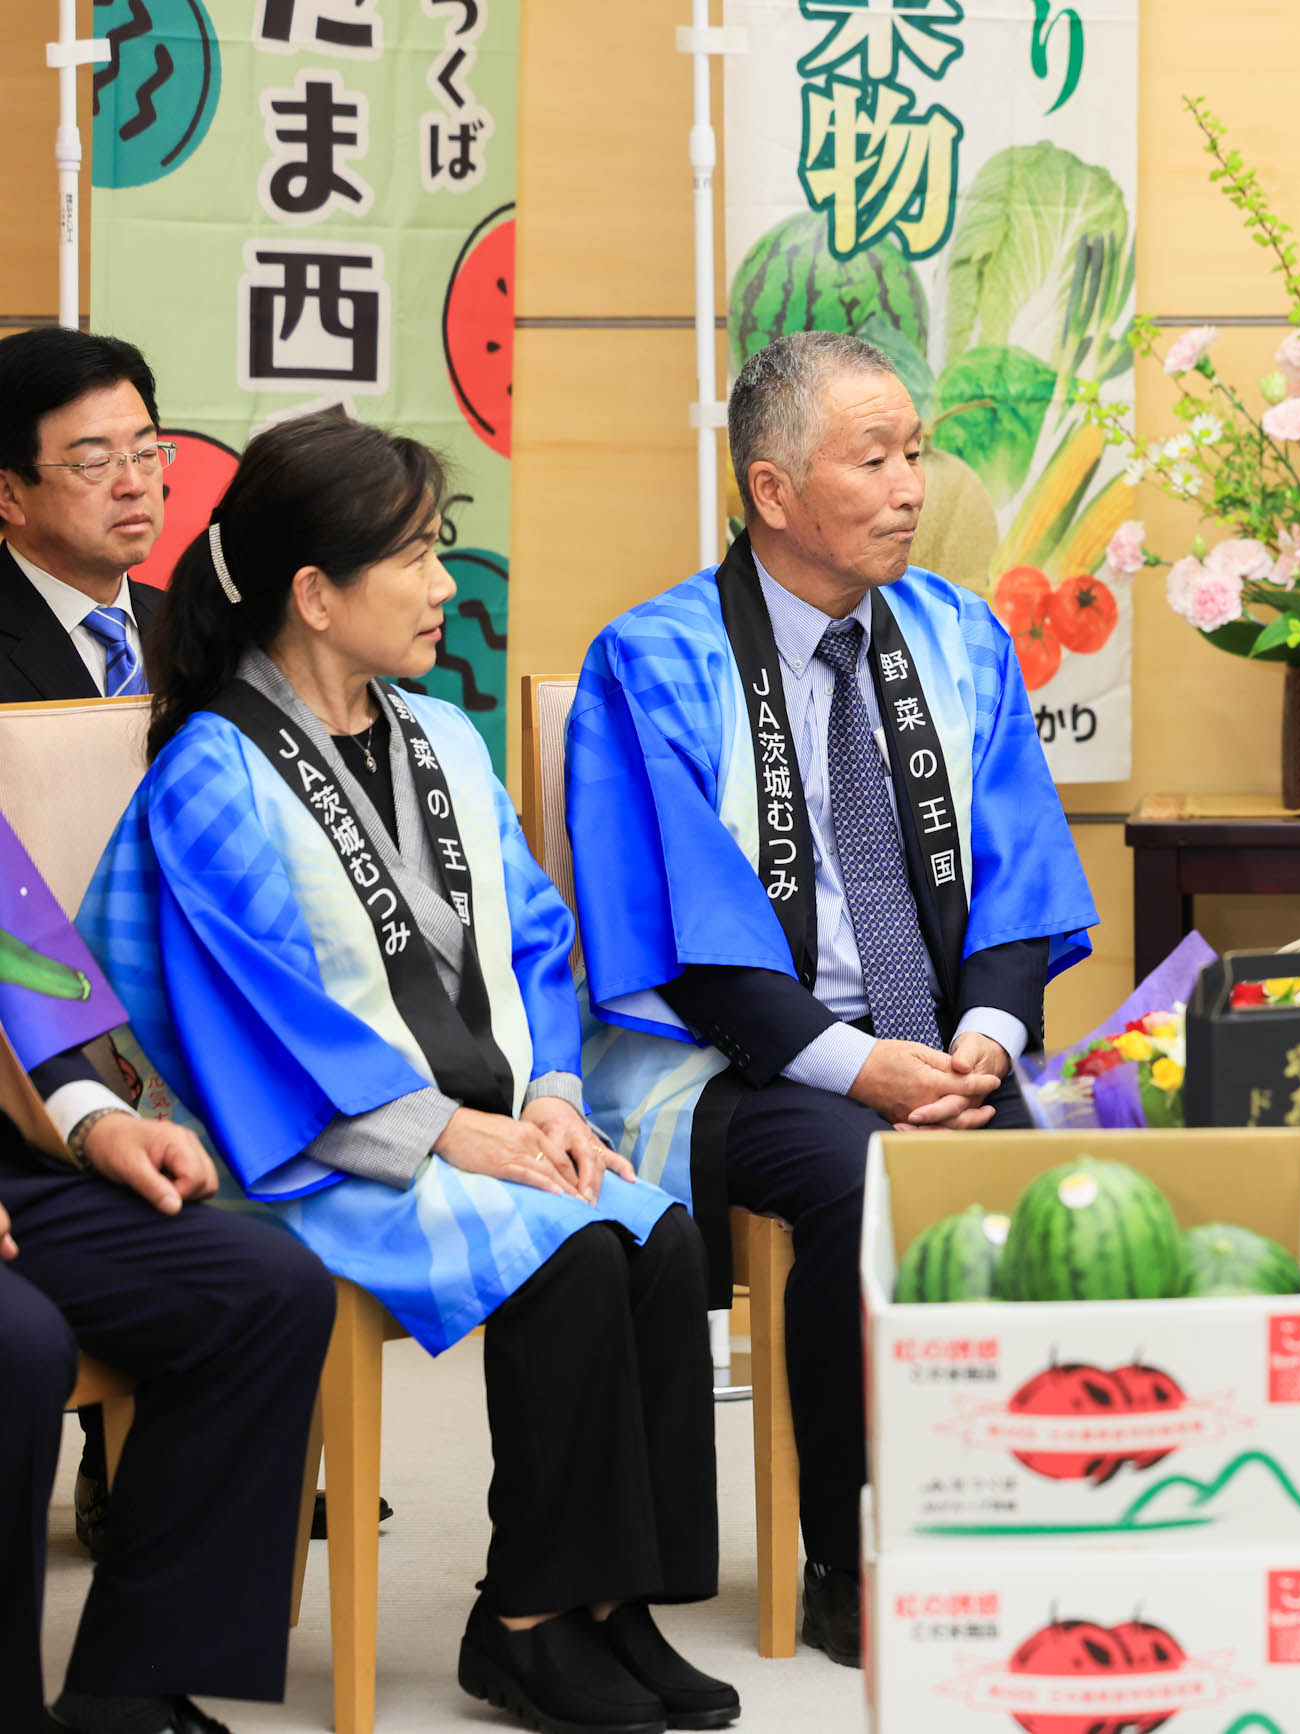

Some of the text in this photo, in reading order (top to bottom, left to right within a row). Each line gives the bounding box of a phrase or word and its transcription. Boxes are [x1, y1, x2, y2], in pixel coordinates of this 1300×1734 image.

[278, 728, 411, 956] JA茨城むつみ
[387, 693, 471, 926] 野菜の王国
[752, 668, 799, 902] JA茨城むつみ
[879, 649, 957, 887] 野菜の王国
[147, 1069, 171, 1121] 元気
